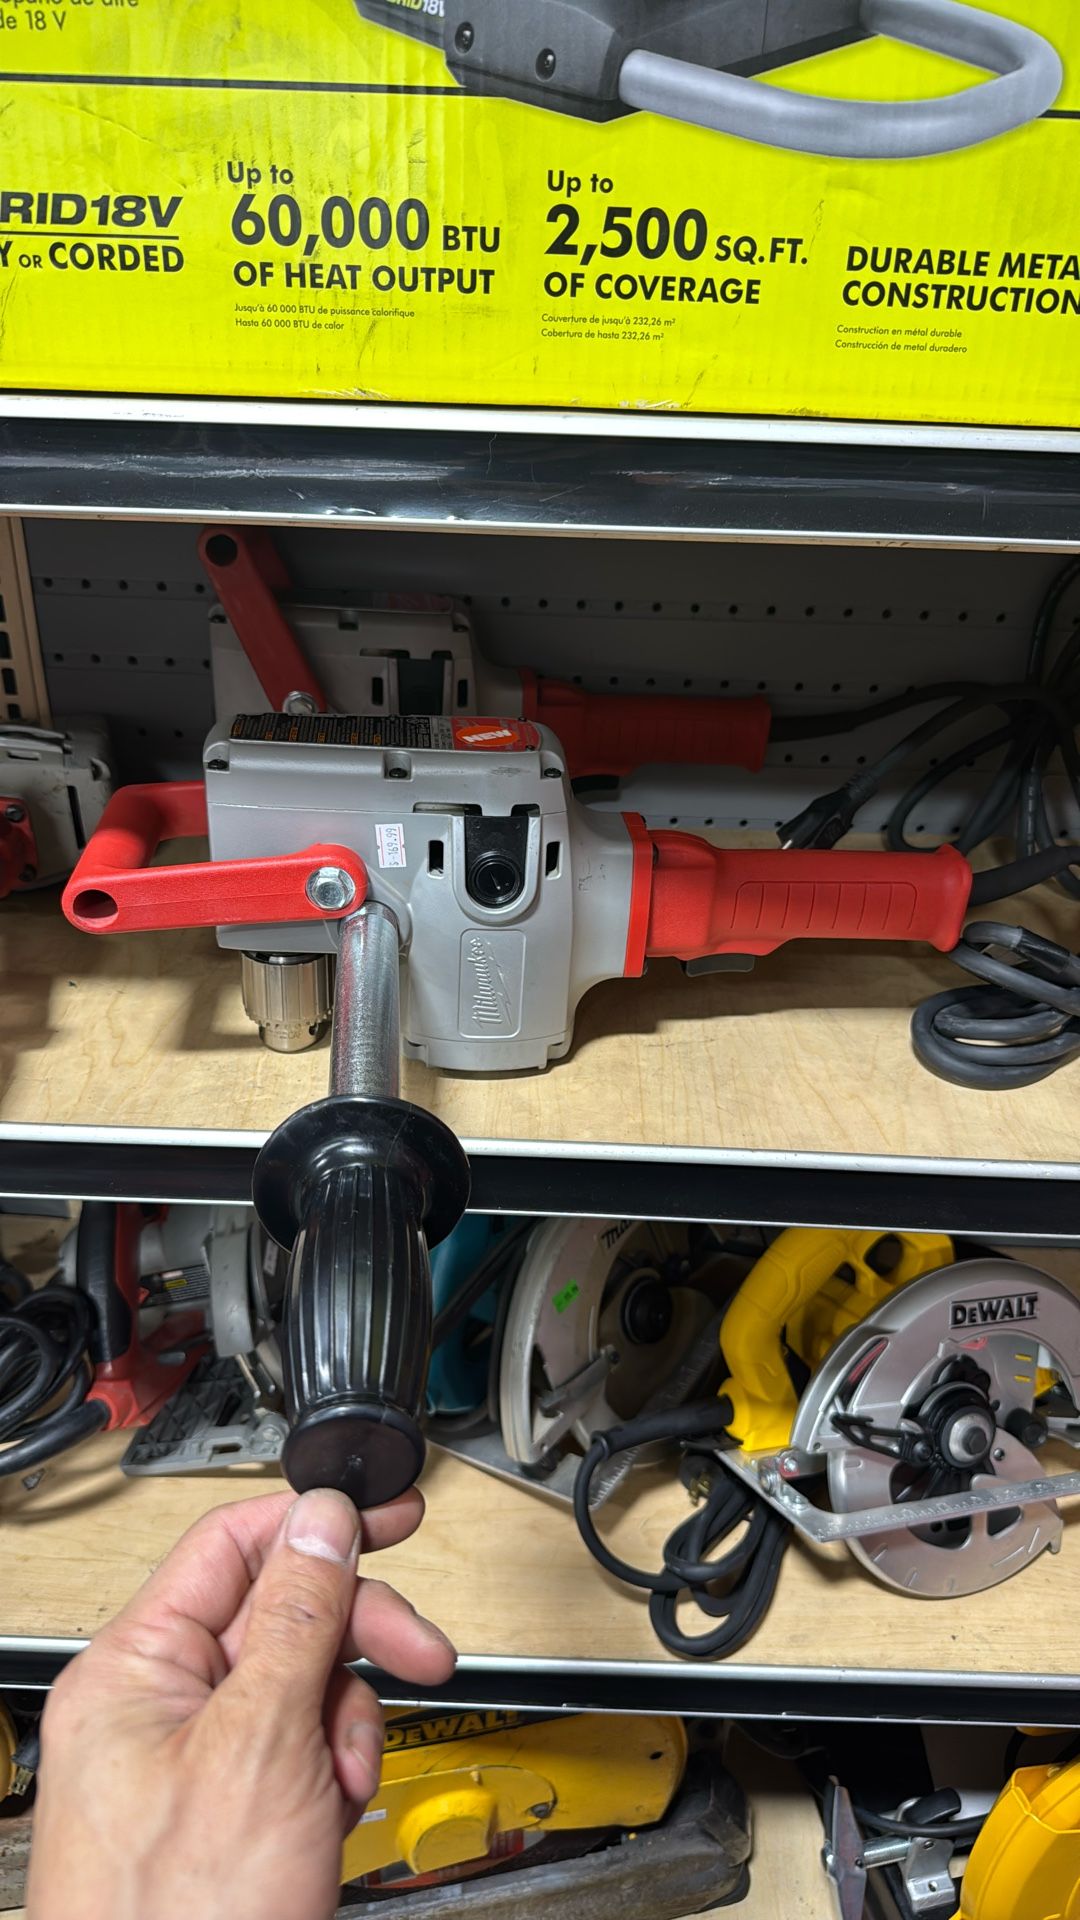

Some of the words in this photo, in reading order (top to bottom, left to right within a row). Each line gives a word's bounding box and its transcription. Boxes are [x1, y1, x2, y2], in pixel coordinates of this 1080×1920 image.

[25, 10, 46, 30] 18
[52, 11, 66, 30] V
[227, 161, 262, 189] Up
[270, 165, 294, 185] to
[547, 169, 582, 198] Up
[590, 173, 614, 194] to
[0, 191, 184, 228] RID18V
[231, 193, 430, 256] 60,000
[442, 224, 500, 253] BTU
[544, 203, 708, 266] 2,500
[18, 254, 43, 269] OR
[49, 241, 185, 273] CORDED
[846, 245, 990, 277] DURABLE
[233, 260, 275, 287] OF
[284, 263, 362, 290] HEAT
[372, 265, 495, 294] OUTPUT
[544, 271, 585, 298] OF
[595, 273, 761, 305] COVERAGE
[267, 304, 278, 313] 60
[280, 304, 297, 314] 000
[299, 305, 316, 314] BTU
[317, 305, 329, 315] de
[330, 306, 370, 317] puissance
[371, 307, 415, 319] calorifique
[842, 280, 1080, 315] CONSTRUCTION
[235, 318, 259, 328] Hasta
[261, 319, 272, 328] 60
[274, 319, 291, 329] 000
[293, 320, 310, 329] BTU
[311, 320, 322, 329] de
[324, 321, 345, 330] calor
[541, 313, 587, 324] Couverture
[589, 315, 600, 324] de
[633, 316, 662, 327] 232,26
[541, 328, 583, 338] Cobertura
[585, 329, 595, 339] de
[597, 330, 620, 340] hasta
[621, 331, 650, 341] 232,26
[836, 324, 889, 336] Construction
[891, 327, 902, 336] en
[904, 327, 928, 337] métal
[930, 328, 963, 339] durable
[835, 339, 888, 350] Construcción
[891, 341, 902, 351] de
[903, 342, 928, 352] metal
[929, 343, 968, 354] duradero
[462, 729, 512, 743] NEW
[467, 936, 503, 1026] Milwaukee
